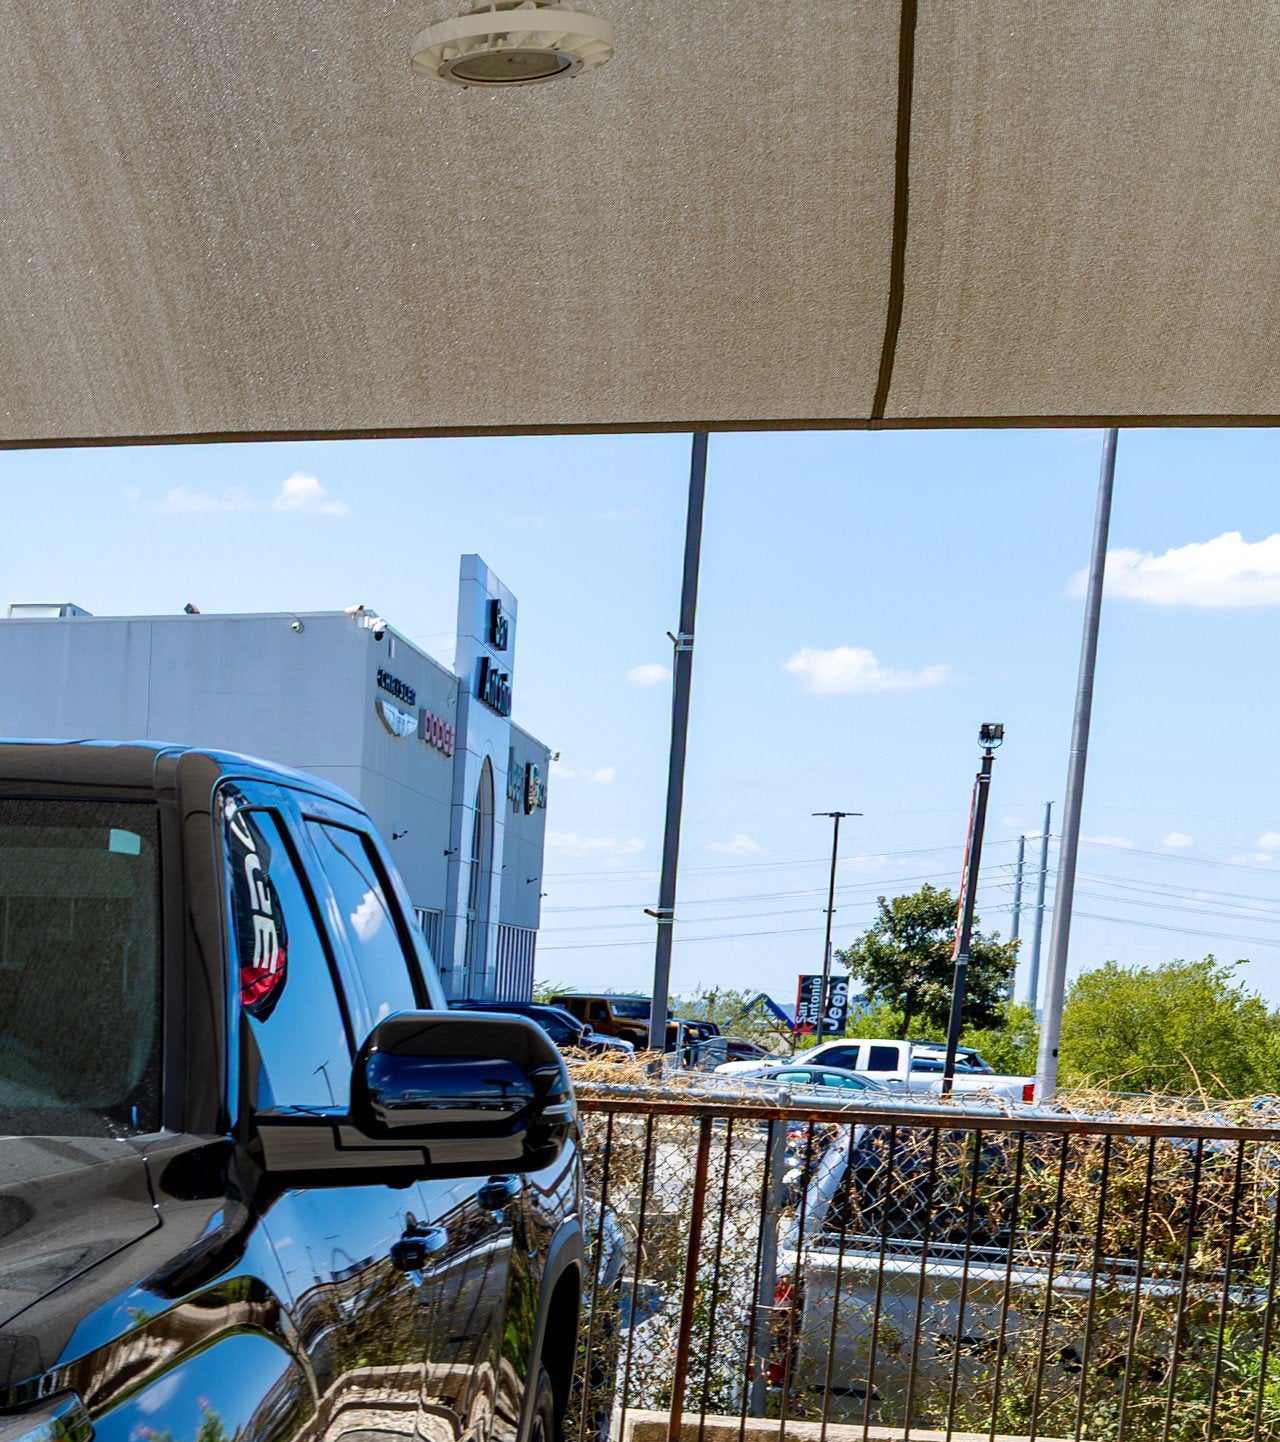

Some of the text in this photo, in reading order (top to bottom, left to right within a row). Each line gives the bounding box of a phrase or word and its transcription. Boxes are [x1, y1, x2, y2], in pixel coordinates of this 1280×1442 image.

[796, 1002, 808, 1023] San
[807, 978, 821, 1025] Antonio
[823, 982, 848, 1031] Jeep
